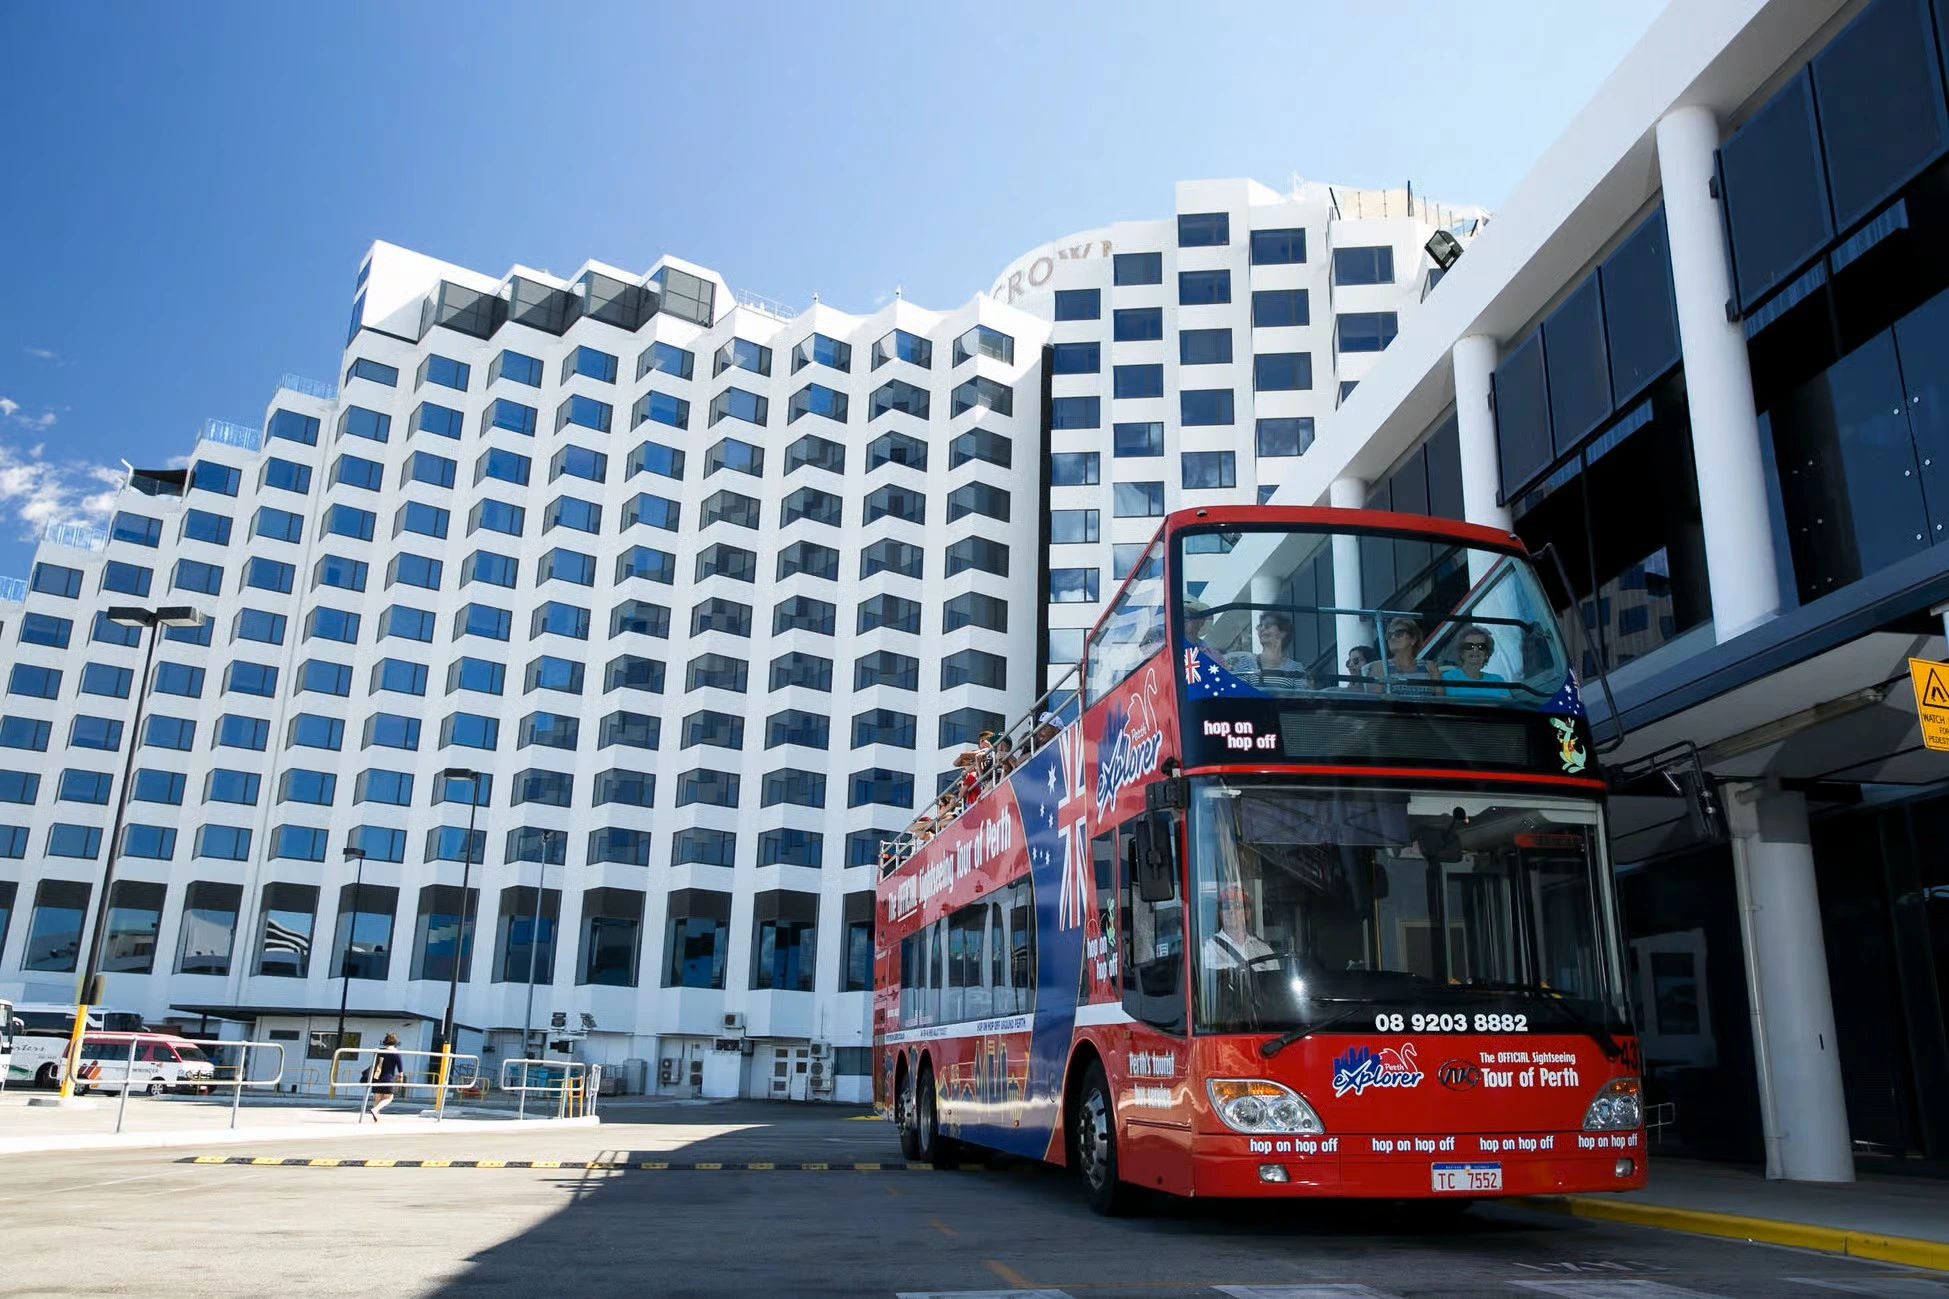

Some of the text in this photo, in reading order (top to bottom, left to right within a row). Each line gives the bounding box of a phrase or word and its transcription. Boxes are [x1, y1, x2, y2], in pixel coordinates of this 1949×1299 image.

[1922, 713, 1945, 724] WATCH
[1131, 722, 1147, 742] Perth
[1203, 720, 1253, 737] hop on
[1227, 734, 1276, 751] hop off
[956, 840, 973, 878] Tour
[974, 820, 984, 869] of
[986, 805, 1012, 862] Perth
[1099, 936, 1107, 955] on
[1375, 1013, 1529, 1032] 08 9203 8882
[1129, 1049, 1151, 1076] Perth's
[1479, 1052, 1576, 1065] The OFFICIAL Sightseeing
[1385, 1063, 1405, 1072] Perth
[1480, 1067, 1513, 1088] Tour
[1519, 1066, 1535, 1088] of
[1539, 1067, 1579, 1087] Perth
[1250, 1137, 1339, 1154] hop on hop off
[1372, 1136, 1455, 1154] hop on hop off
[1479, 1135, 1555, 1152] hop on hop off
[1578, 1133, 1638, 1150] hop on hop off
[1438, 1172, 1497, 1189] TC 7552
